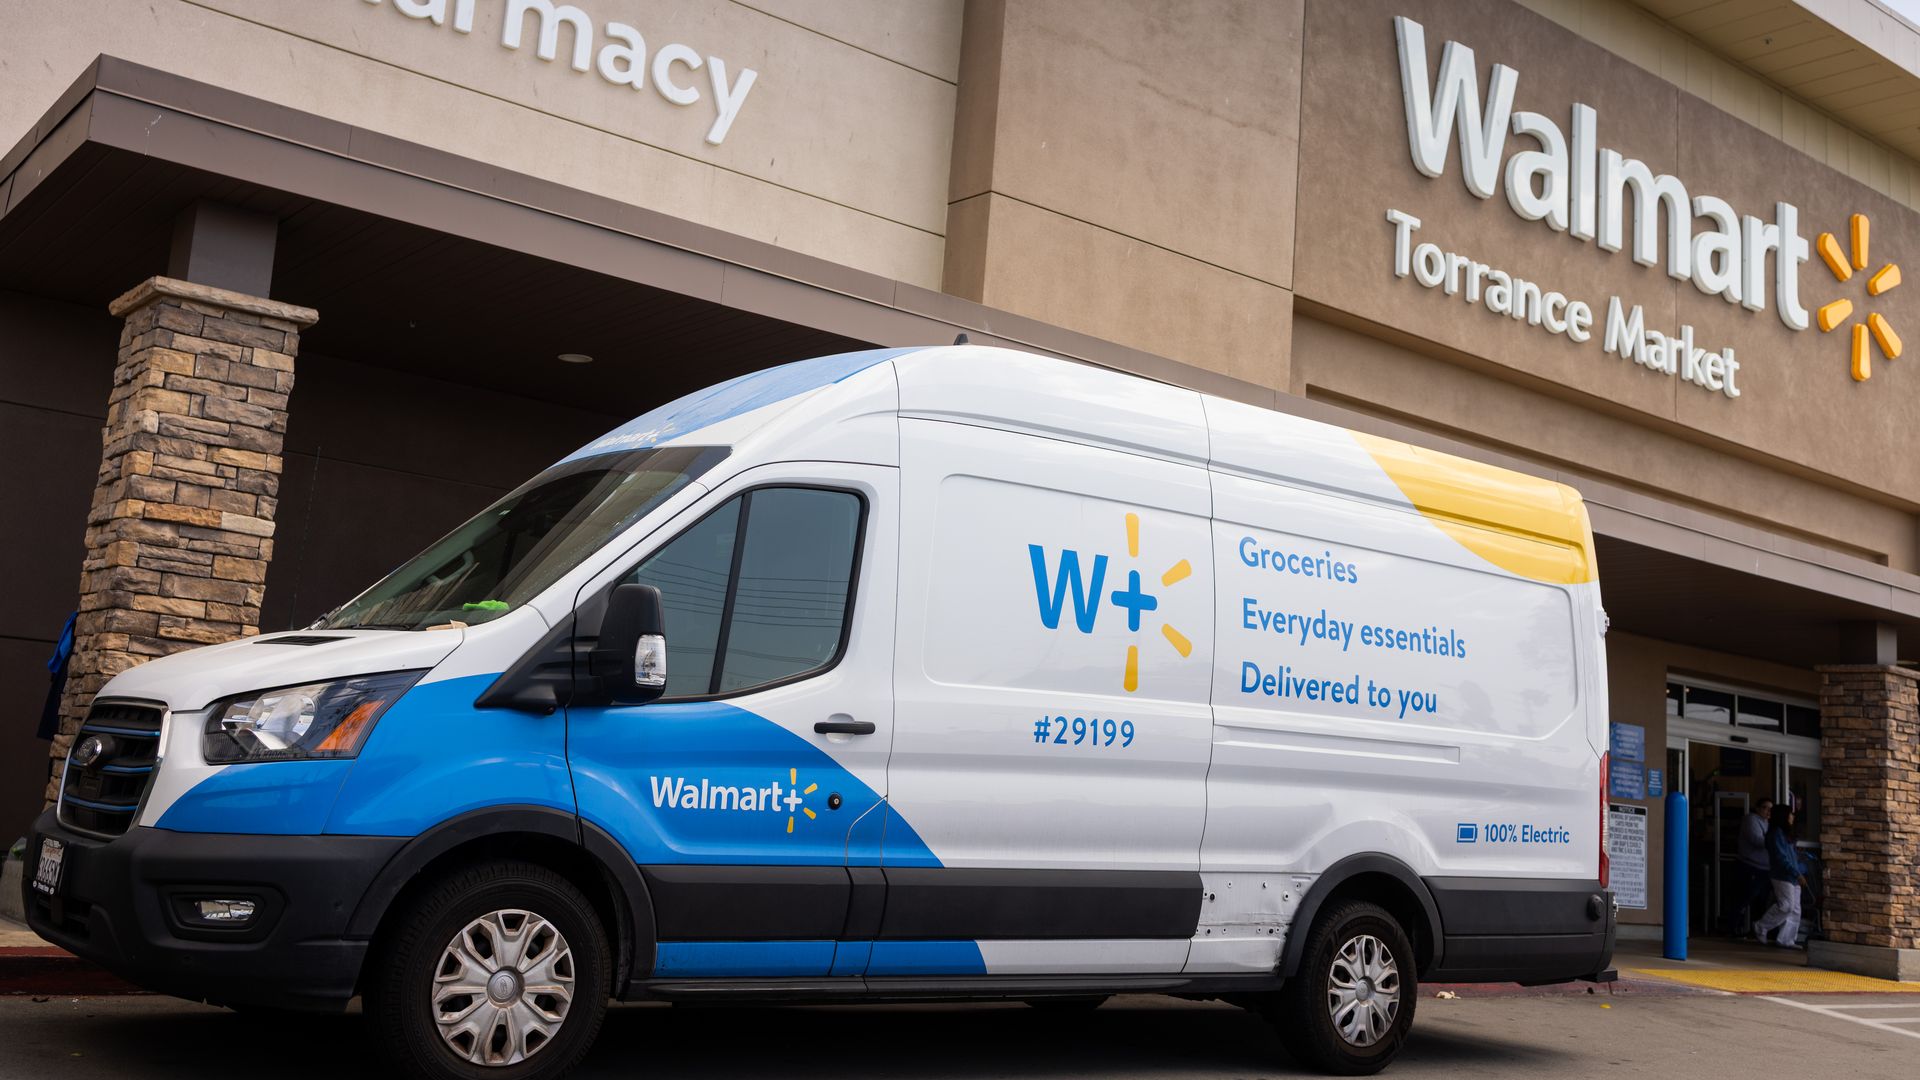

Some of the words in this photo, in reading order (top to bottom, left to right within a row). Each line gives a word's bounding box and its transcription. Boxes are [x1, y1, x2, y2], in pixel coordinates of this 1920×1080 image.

[366, 0, 758, 146] macy
[1394, 16, 1809, 331] Walmart
[1386, 208, 1593, 343] Torrance
[1604, 295, 1741, 398] Market
[1239, 536, 1358, 584] Groceries
[1243, 597, 1354, 652] Everyday
[1360, 623, 1467, 659] essentials
[1241, 661, 1360, 706] Delivered
[1368, 679, 1391, 708] to
[1398, 689, 1438, 720] you
[1033, 714, 1136, 749] #29199
[1484, 823, 1518, 843] 100%
[1521, 824, 1570, 844] Electric
